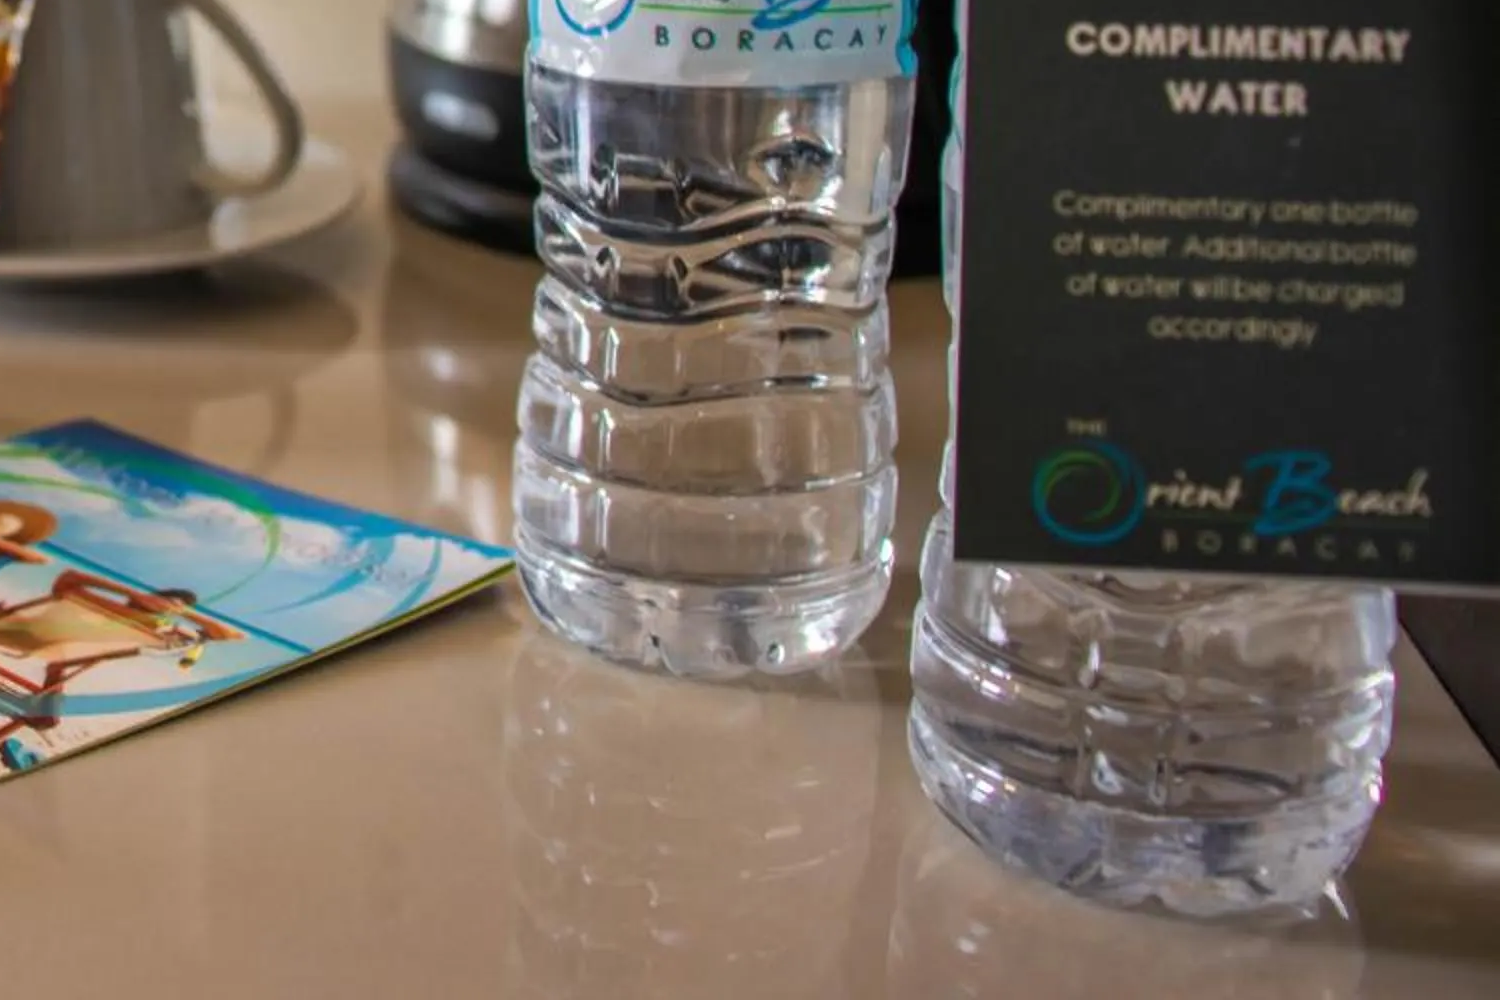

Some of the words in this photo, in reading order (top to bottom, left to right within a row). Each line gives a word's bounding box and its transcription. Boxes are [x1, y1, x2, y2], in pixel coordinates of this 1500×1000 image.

[654, 23, 889, 52] BORACAY
[1065, 21, 1410, 63] COMPLIMENTARY
[1165, 80, 1308, 115] WATER
[1052, 188, 1266, 228] Complimentary
[1268, 200, 1325, 223] one
[1328, 199, 1419, 226] bottle
[1051, 231, 1085, 256] of
[1181, 234, 1324, 263] Additional
[1328, 238, 1417, 266] bottle
[1065, 272, 1098, 297] of
[1101, 273, 1183, 299] water
[1234, 275, 1272, 300] be
[1275, 279, 1404, 311] charged
[1031, 440, 1245, 546] Orient
[1245, 447, 1433, 537] Beach
[1160, 528, 1418, 562] BORACAY
